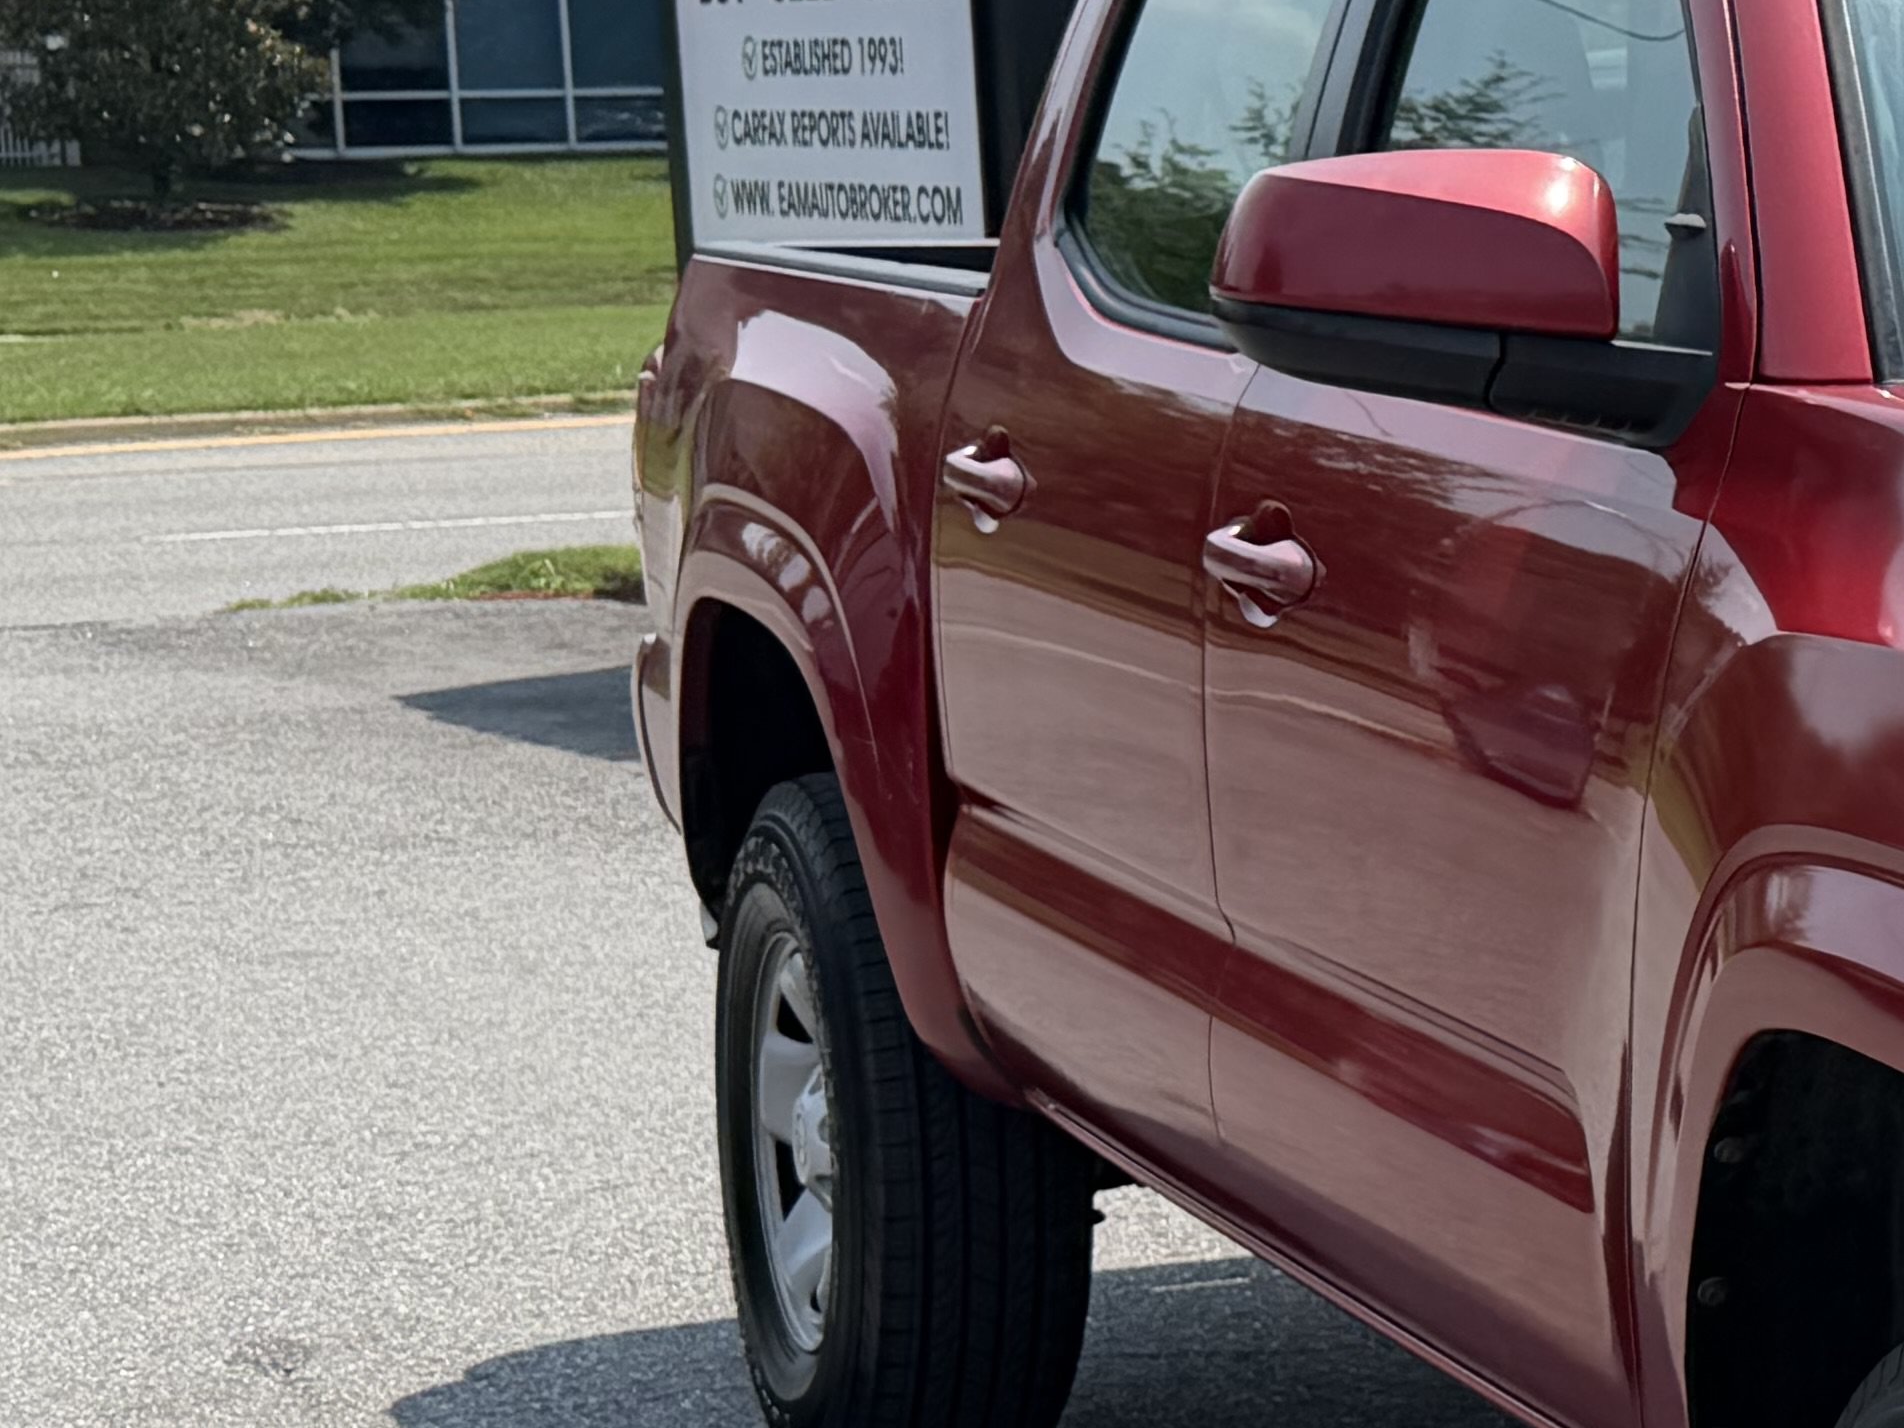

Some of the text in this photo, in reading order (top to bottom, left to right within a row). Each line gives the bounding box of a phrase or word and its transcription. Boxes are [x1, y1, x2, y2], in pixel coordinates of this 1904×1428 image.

[761, 37, 905, 77] ESTABLISHED 1993!
[731, 109, 950, 150] CARFAX REPORTS AVAILABLE!
